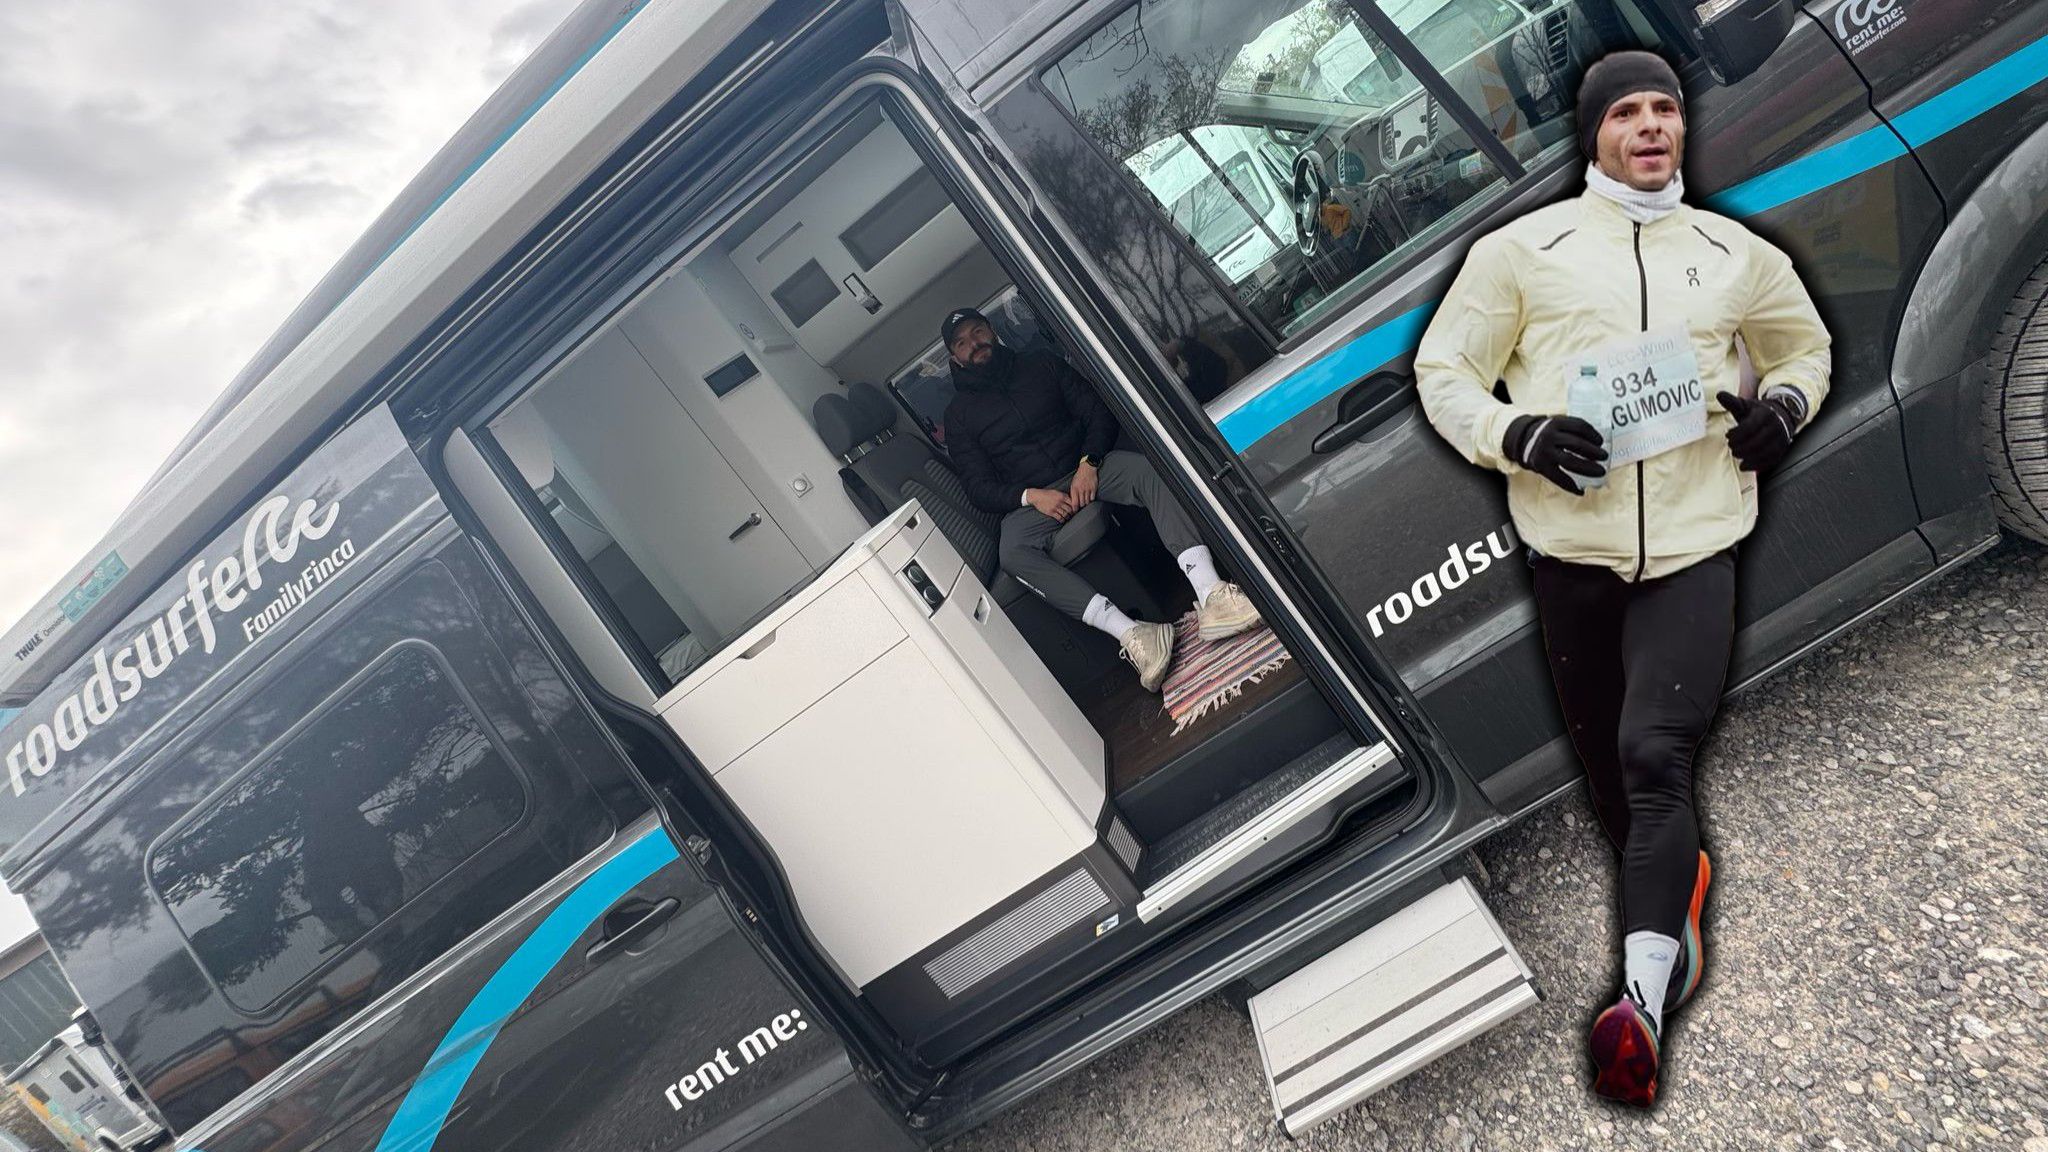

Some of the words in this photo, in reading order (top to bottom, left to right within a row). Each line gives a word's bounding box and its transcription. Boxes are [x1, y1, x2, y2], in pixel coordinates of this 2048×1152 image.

[1845, 23, 1876, 50] rent
[1876, 6, 1905, 29] me:
[1851, 15, 1907, 56] roadsurfer.com
[1611, 366, 1657, 398] 934
[1611, 379, 1701, 430] GUMOVIC
[242, 539, 356, 642] FamilyFinca
[15, 633, 44, 661] THULE
[664, 1047, 740, 1111] rent
[737, 1008, 808, 1065] me:
